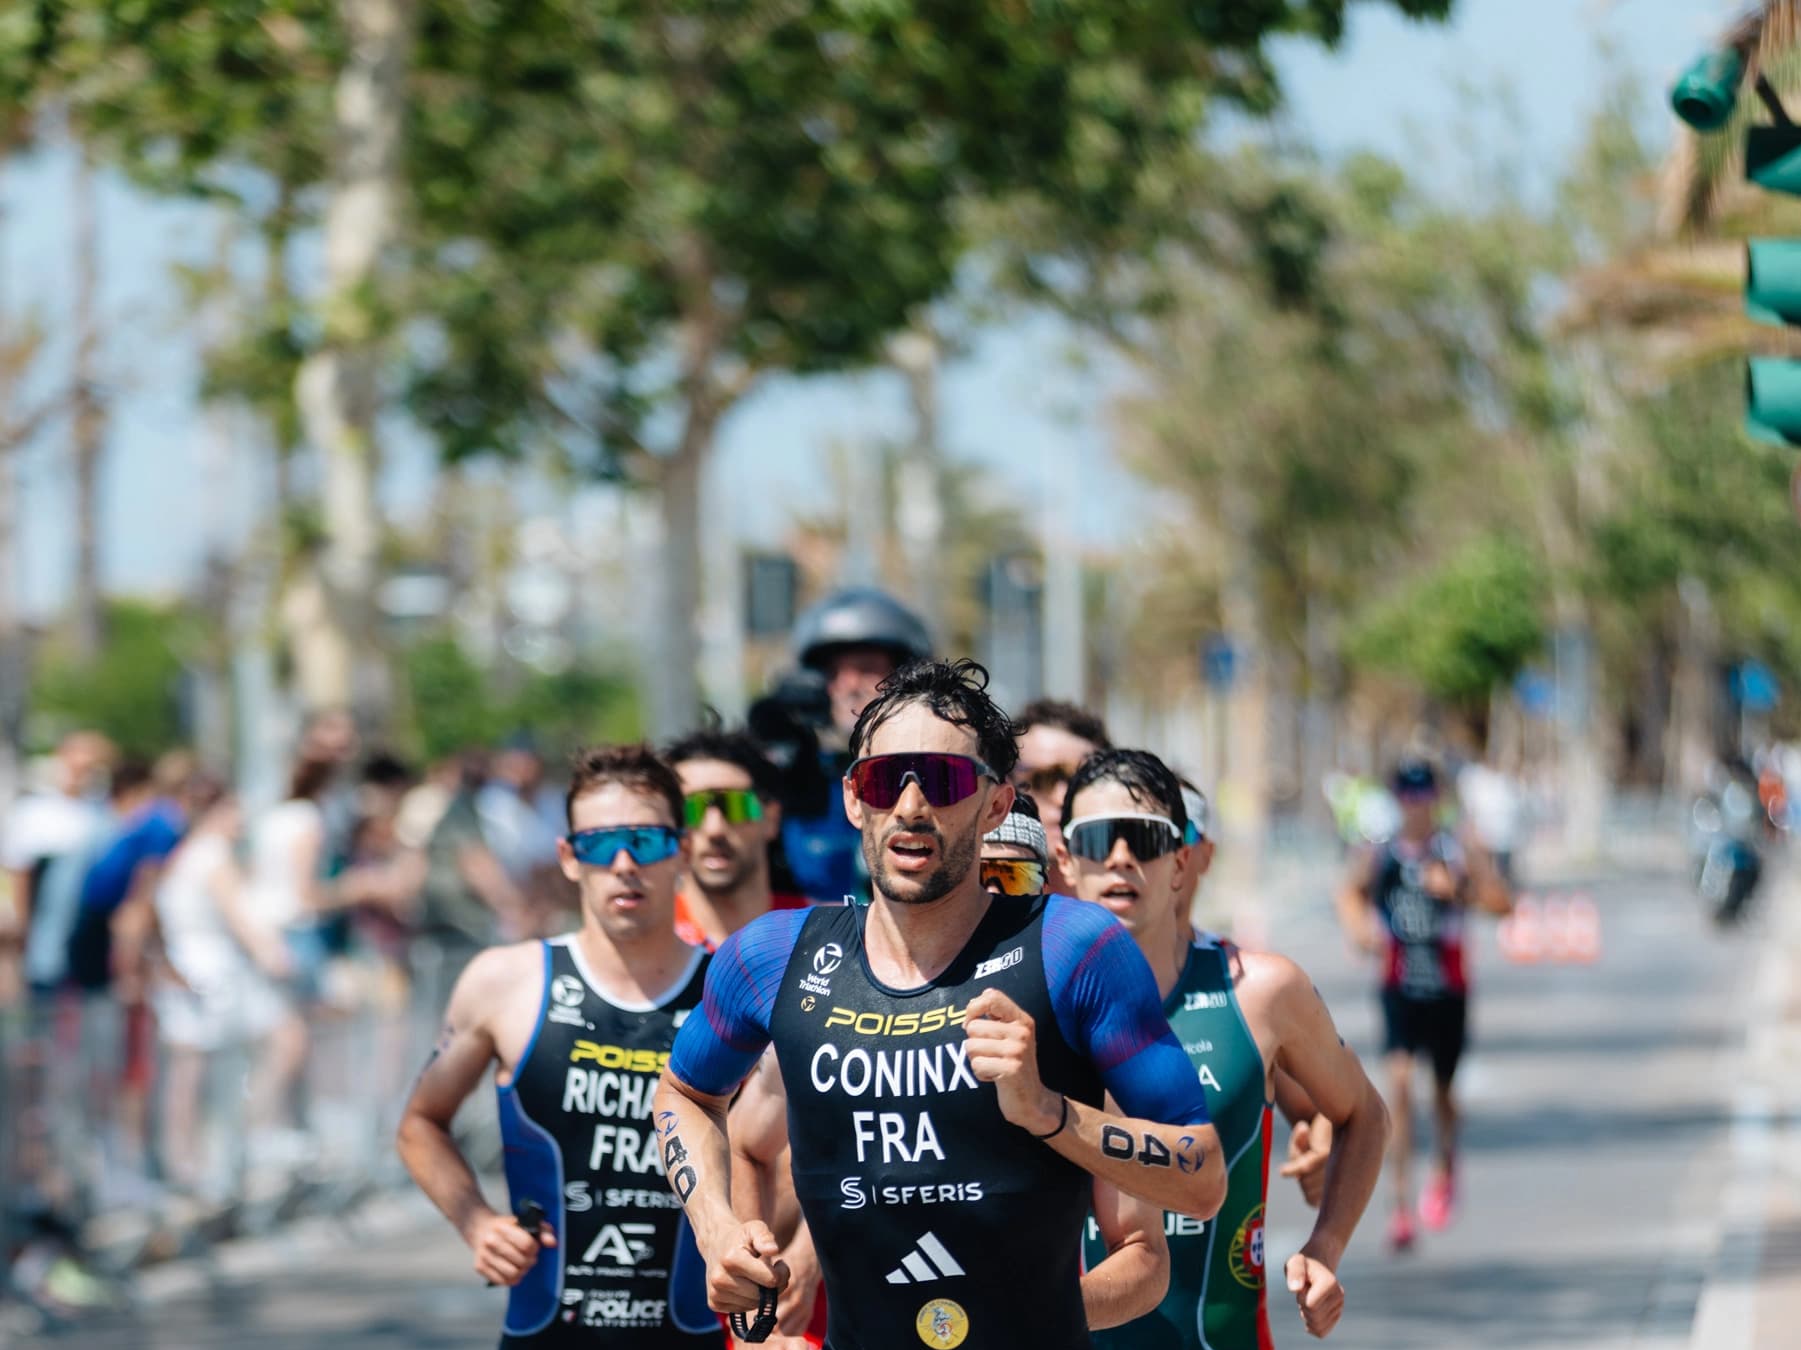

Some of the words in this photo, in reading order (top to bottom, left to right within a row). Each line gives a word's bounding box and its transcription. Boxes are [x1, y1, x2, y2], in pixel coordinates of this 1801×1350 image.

[798, 980, 832, 997] Triathlon
[806, 972, 831, 987] World
[810, 1040, 978, 1098] CONINX
[588, 1123, 667, 1178] FRA
[852, 1110, 947, 1164] FRA
[664, 1135, 697, 1204] 40
[585, 1299, 667, 1320] POLICE
